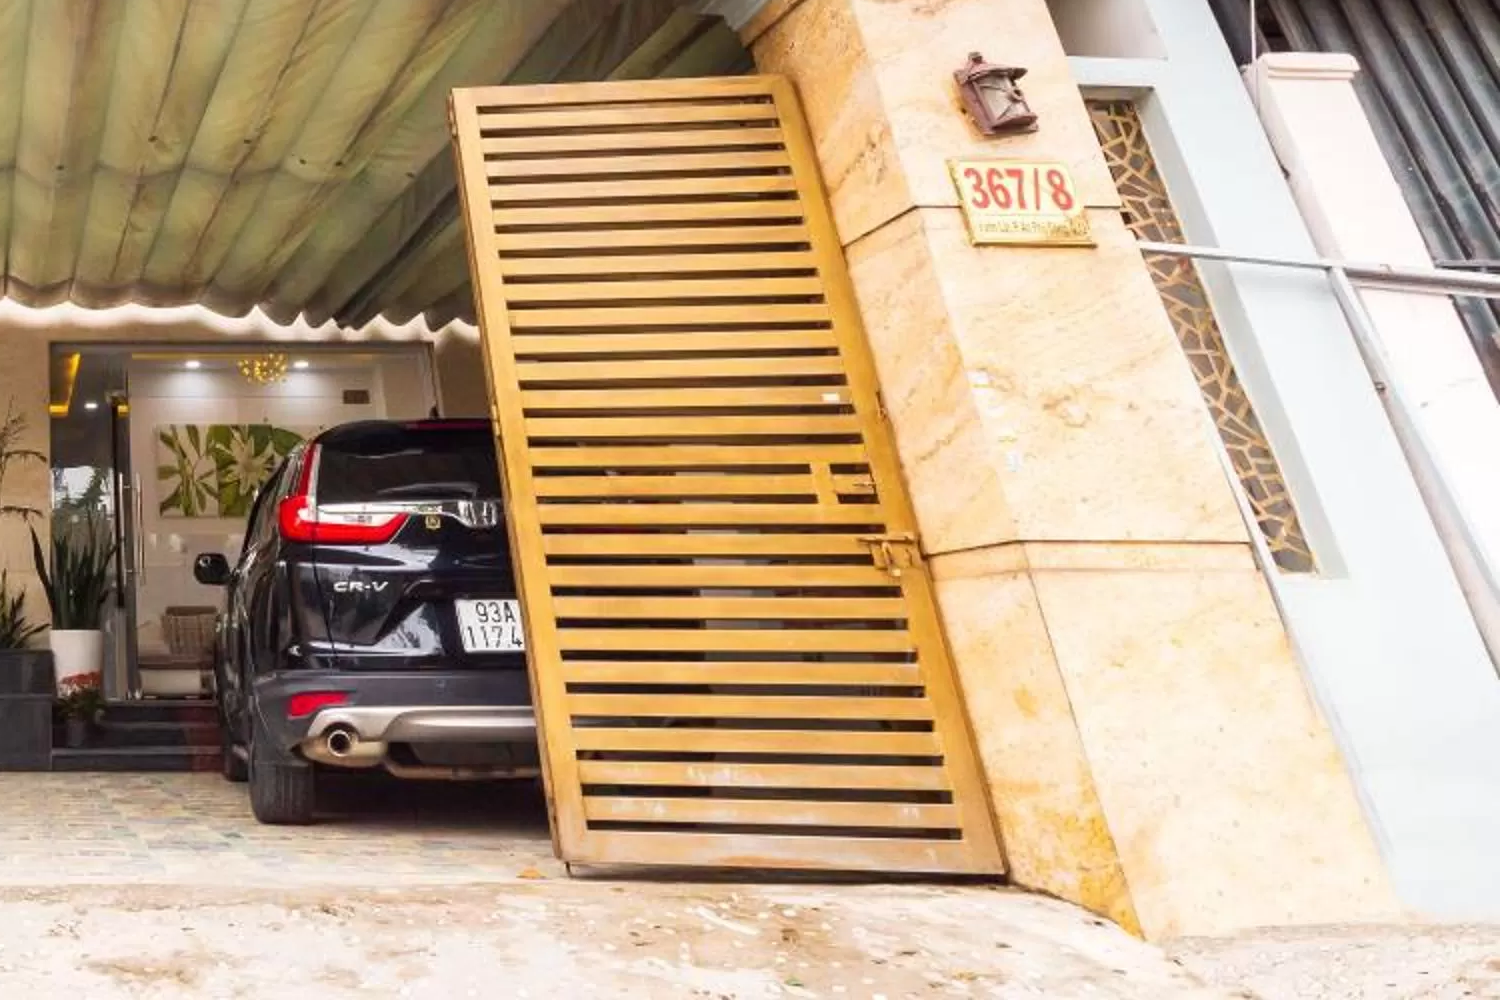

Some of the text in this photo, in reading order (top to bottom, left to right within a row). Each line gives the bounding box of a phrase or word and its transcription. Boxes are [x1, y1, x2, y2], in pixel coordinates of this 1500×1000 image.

[963, 167, 1073, 211] 367/8
[333, 581, 389, 593] CR-V
[475, 601, 516, 623] 93A
[467, 625, 523, 649] 117.4
